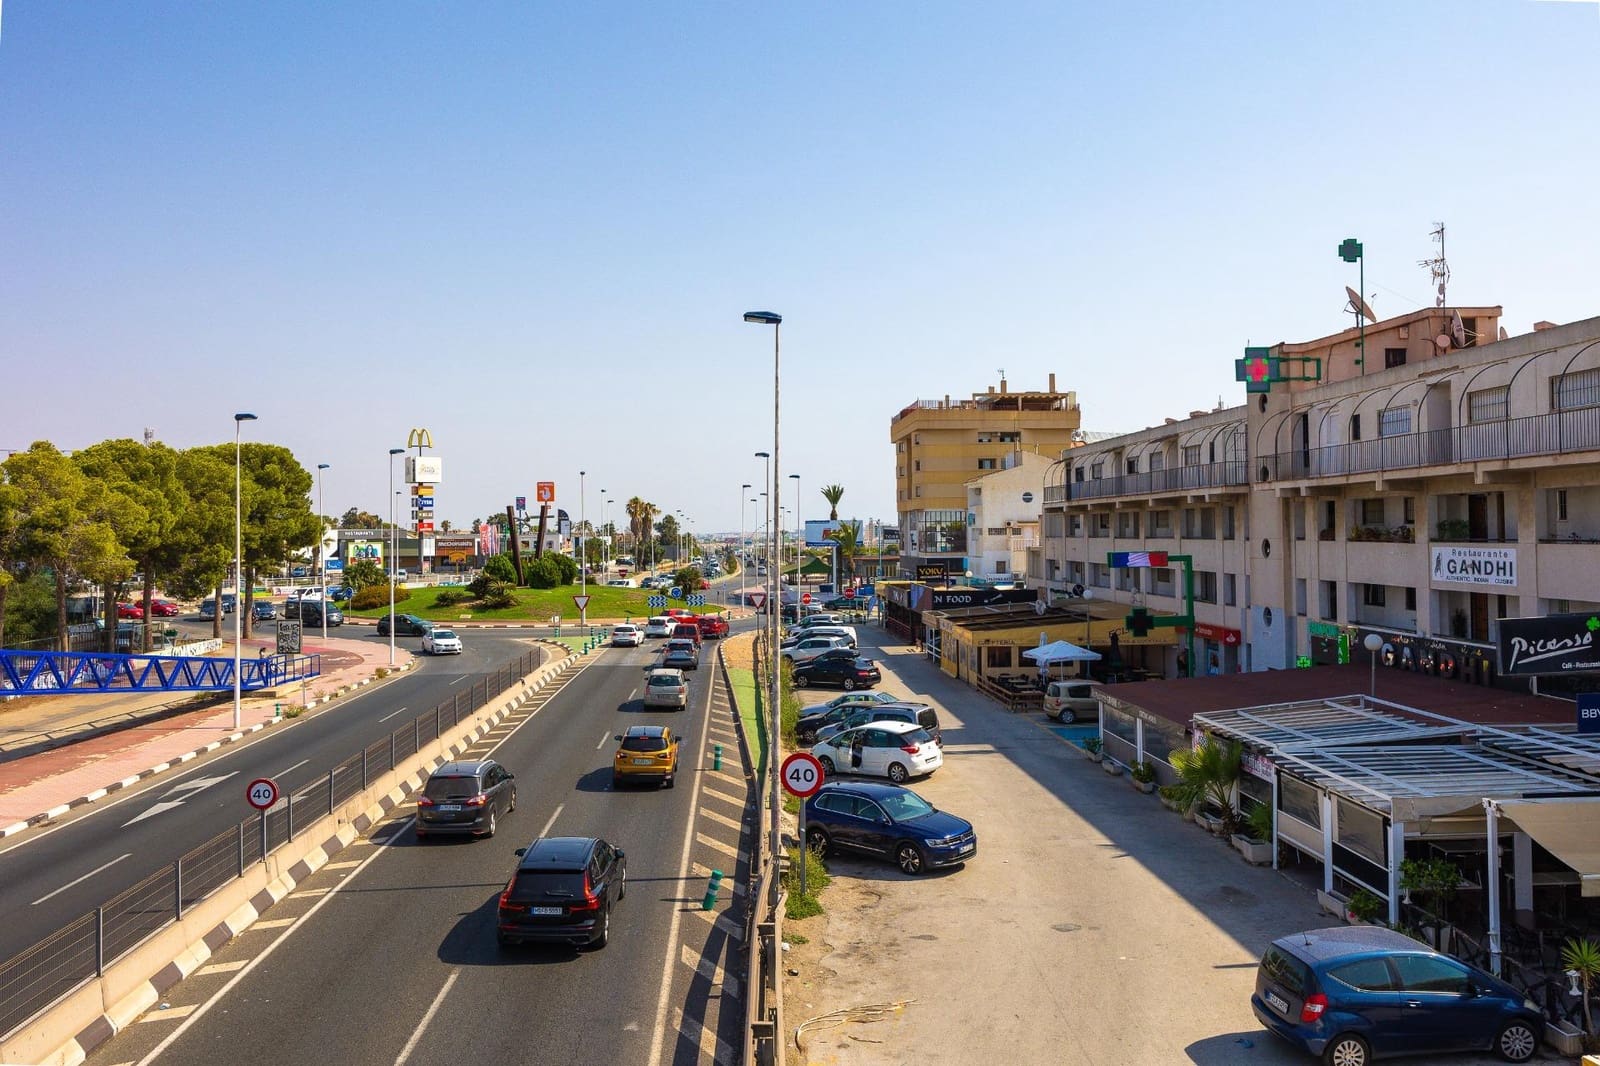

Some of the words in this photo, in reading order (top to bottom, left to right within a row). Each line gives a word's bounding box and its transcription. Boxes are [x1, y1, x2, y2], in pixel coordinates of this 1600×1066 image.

[1452, 549, 1508, 559] Restaurante
[1447, 559, 1513, 577] GANDHI
[946, 595, 972, 603] FOOD
[1509, 631, 1593, 673] Picasso
[789, 768, 815, 782] 40
[253, 788, 271, 799] 40
